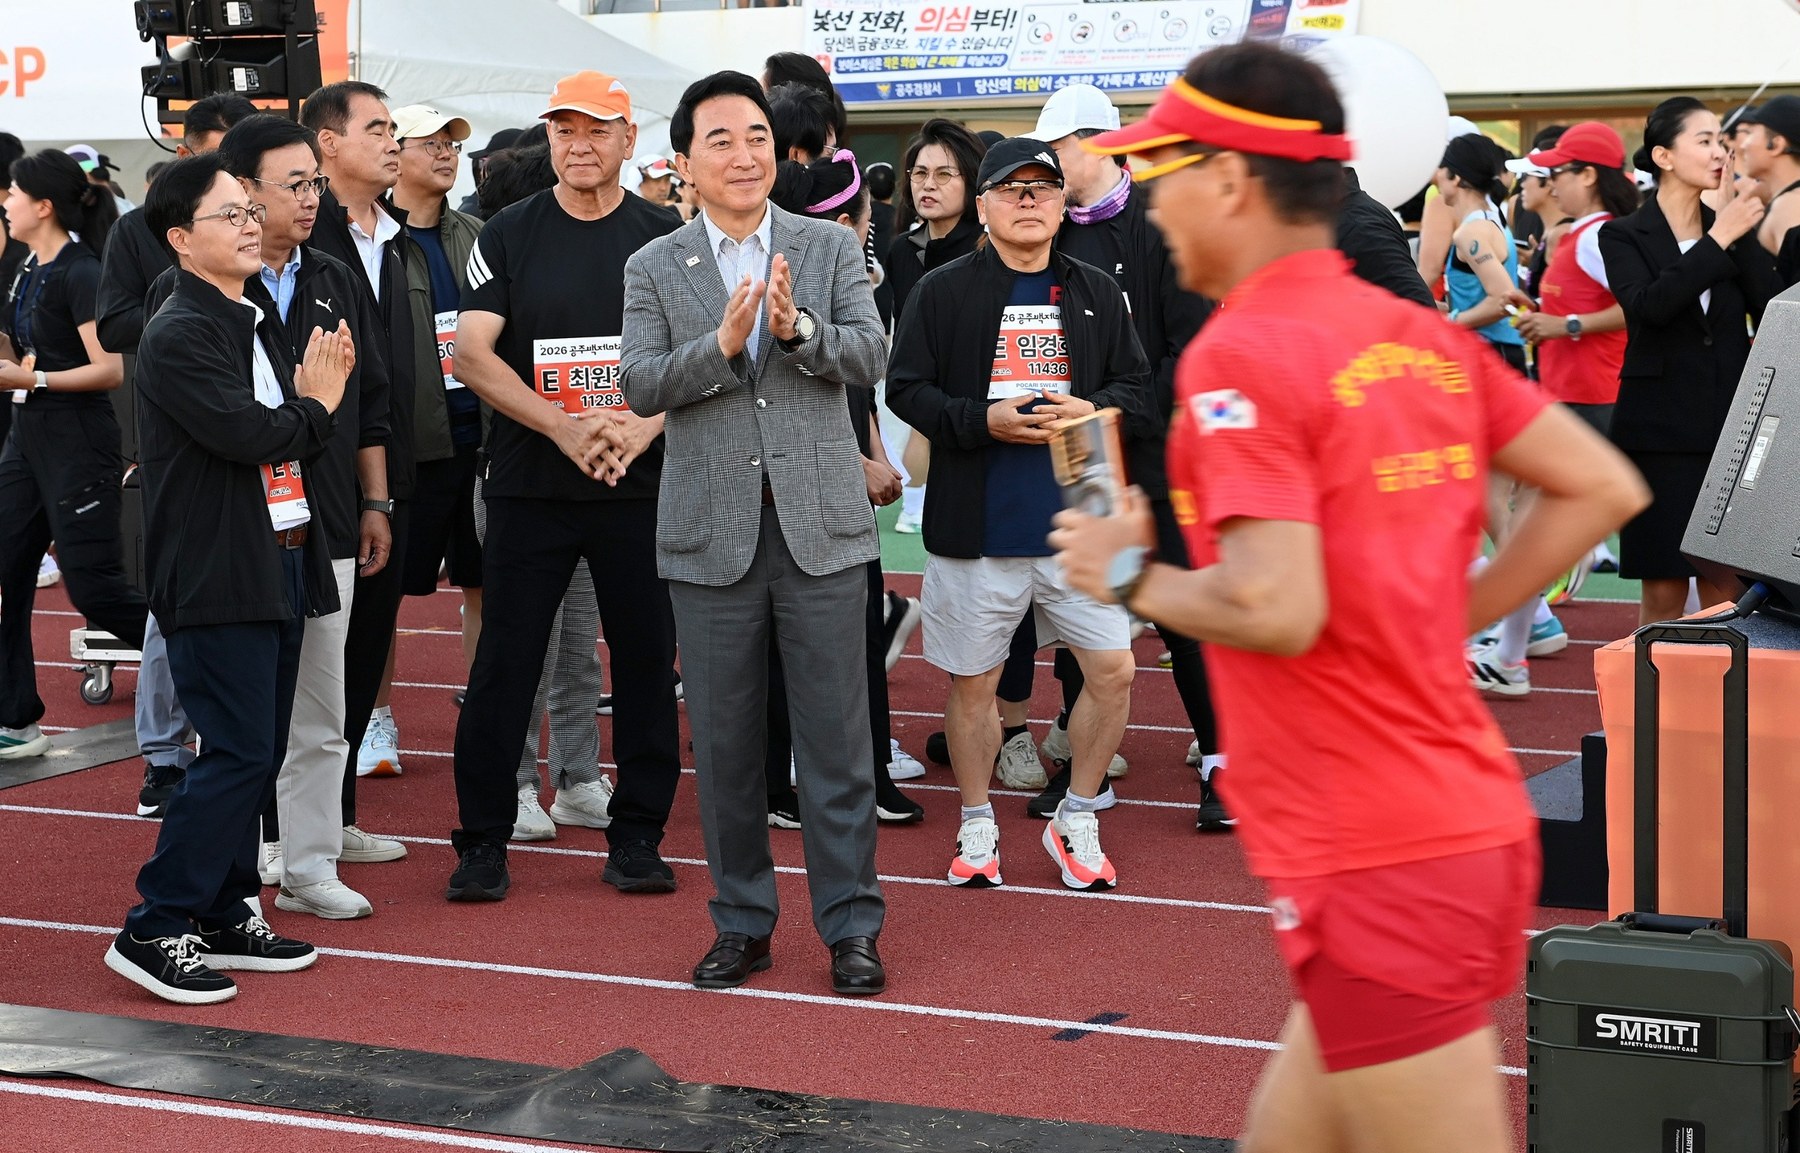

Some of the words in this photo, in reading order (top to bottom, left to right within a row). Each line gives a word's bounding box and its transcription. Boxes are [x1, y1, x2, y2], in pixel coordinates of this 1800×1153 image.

[824, 36, 855, 53] 당신의
[944, 37, 957, 50] 수
[962, 36, 1013, 51] 있습니다
[0, 47, 46, 97] P
[895, 82, 942, 97] 공주경찰서
[974, 79, 1012, 95] 당신의
[1014, 77, 1053, 93] 의심이
[540, 346, 568, 356] 2026
[1028, 362, 1068, 375] 11436
[541, 369, 560, 393] E
[581, 394, 623, 408] 11283
[1595, 1013, 1700, 1047] SMRITI
[1620, 1040, 1643, 1048] SAFETY
[1644, 1042, 1681, 1051] EQUIPMENT
